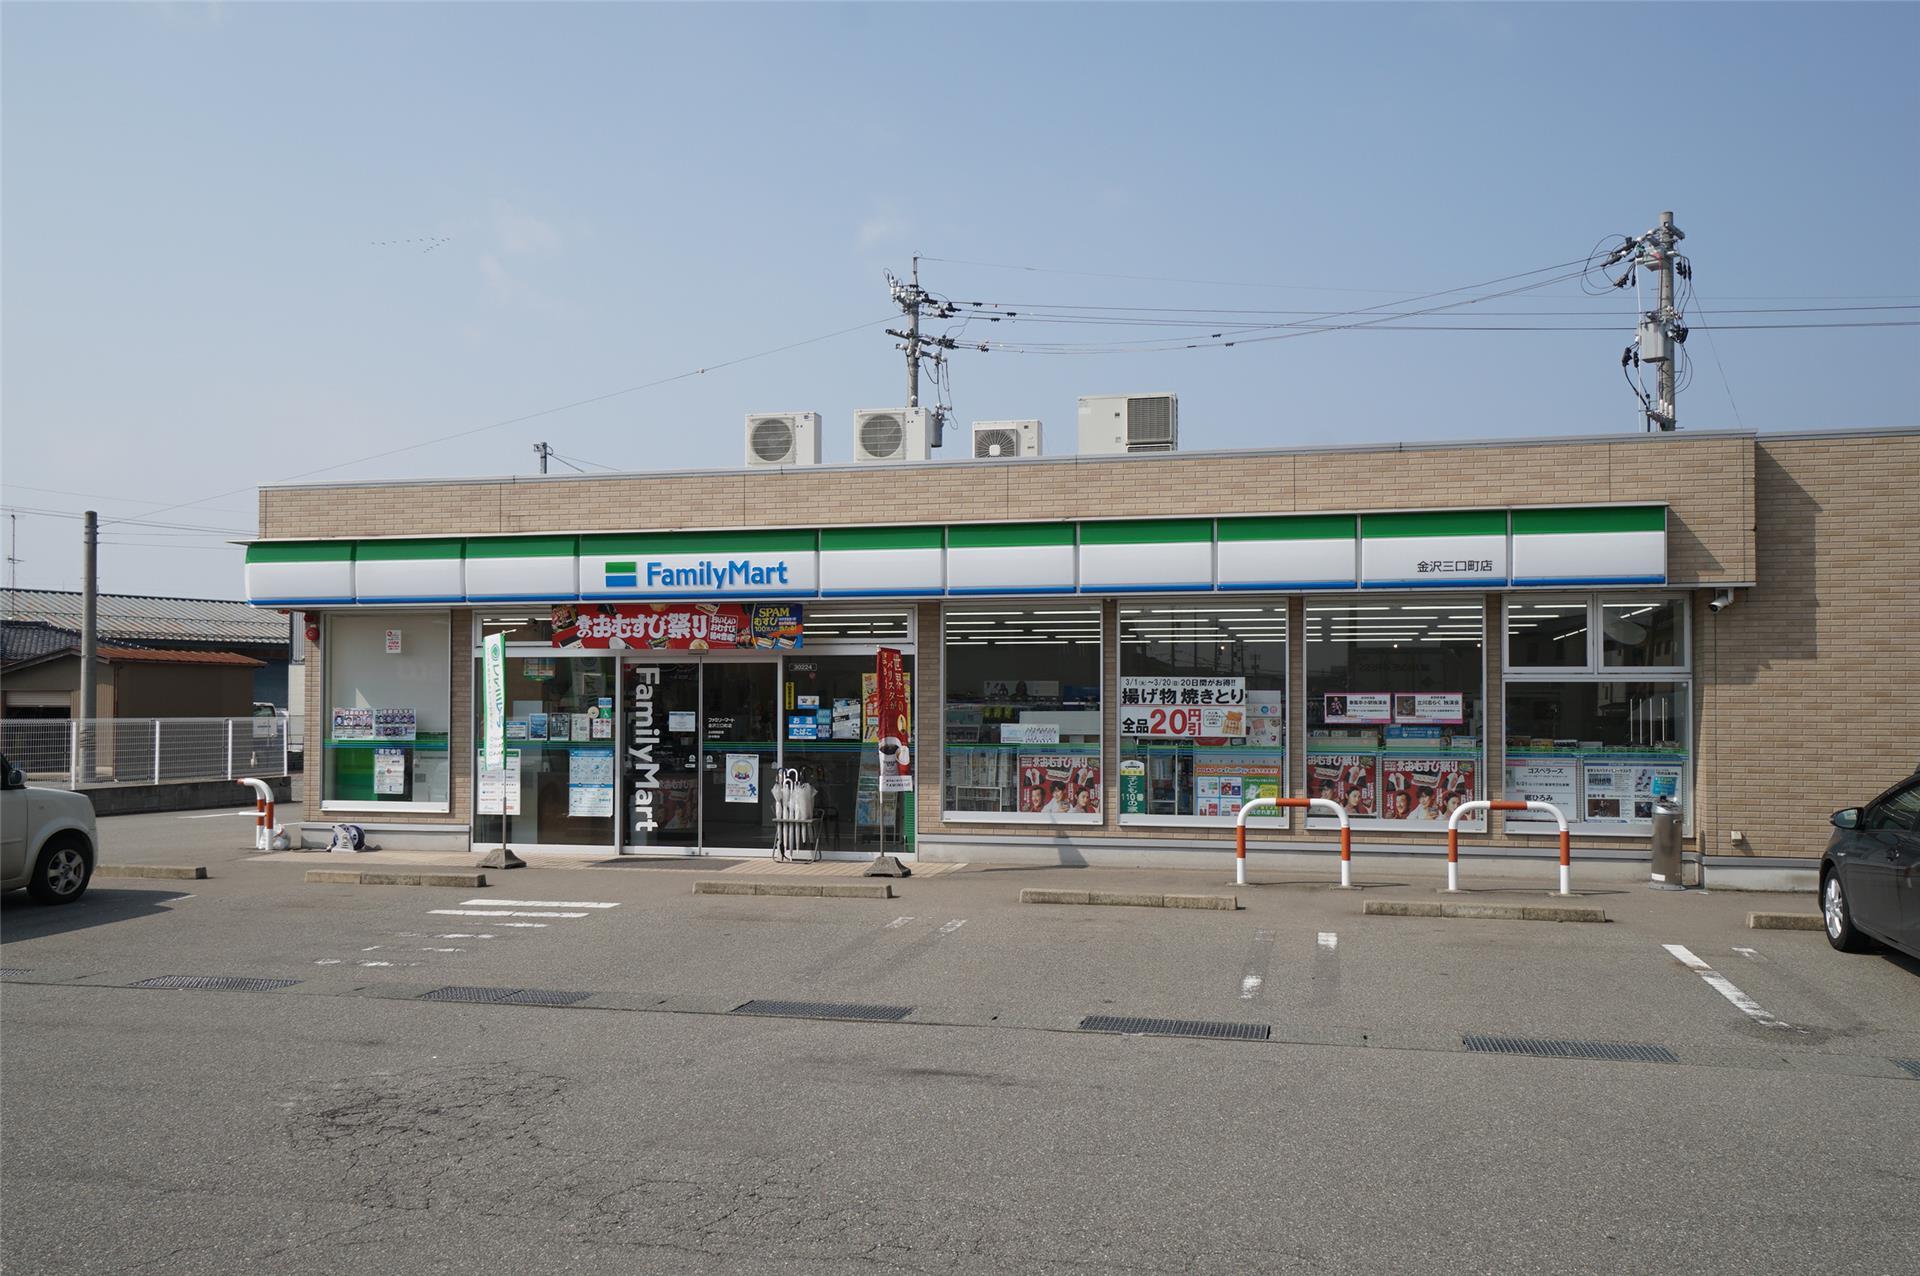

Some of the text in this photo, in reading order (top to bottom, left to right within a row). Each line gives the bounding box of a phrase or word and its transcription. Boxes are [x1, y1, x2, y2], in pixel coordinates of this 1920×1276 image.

[1417, 560, 1492, 573] 金沢三口町店
[647, 560, 789, 589] FamilyMart
[758, 607, 790, 617] SPAM
[753, 617, 777, 626] むすび
[1122, 687, 1244, 705] 揚げ物 焼きとり
[627, 667, 661, 832] FamilyMart
[1528, 767, 1564, 775] ゴスペラーズ
[1524, 794, 1553, 802] 郷ひろみ
